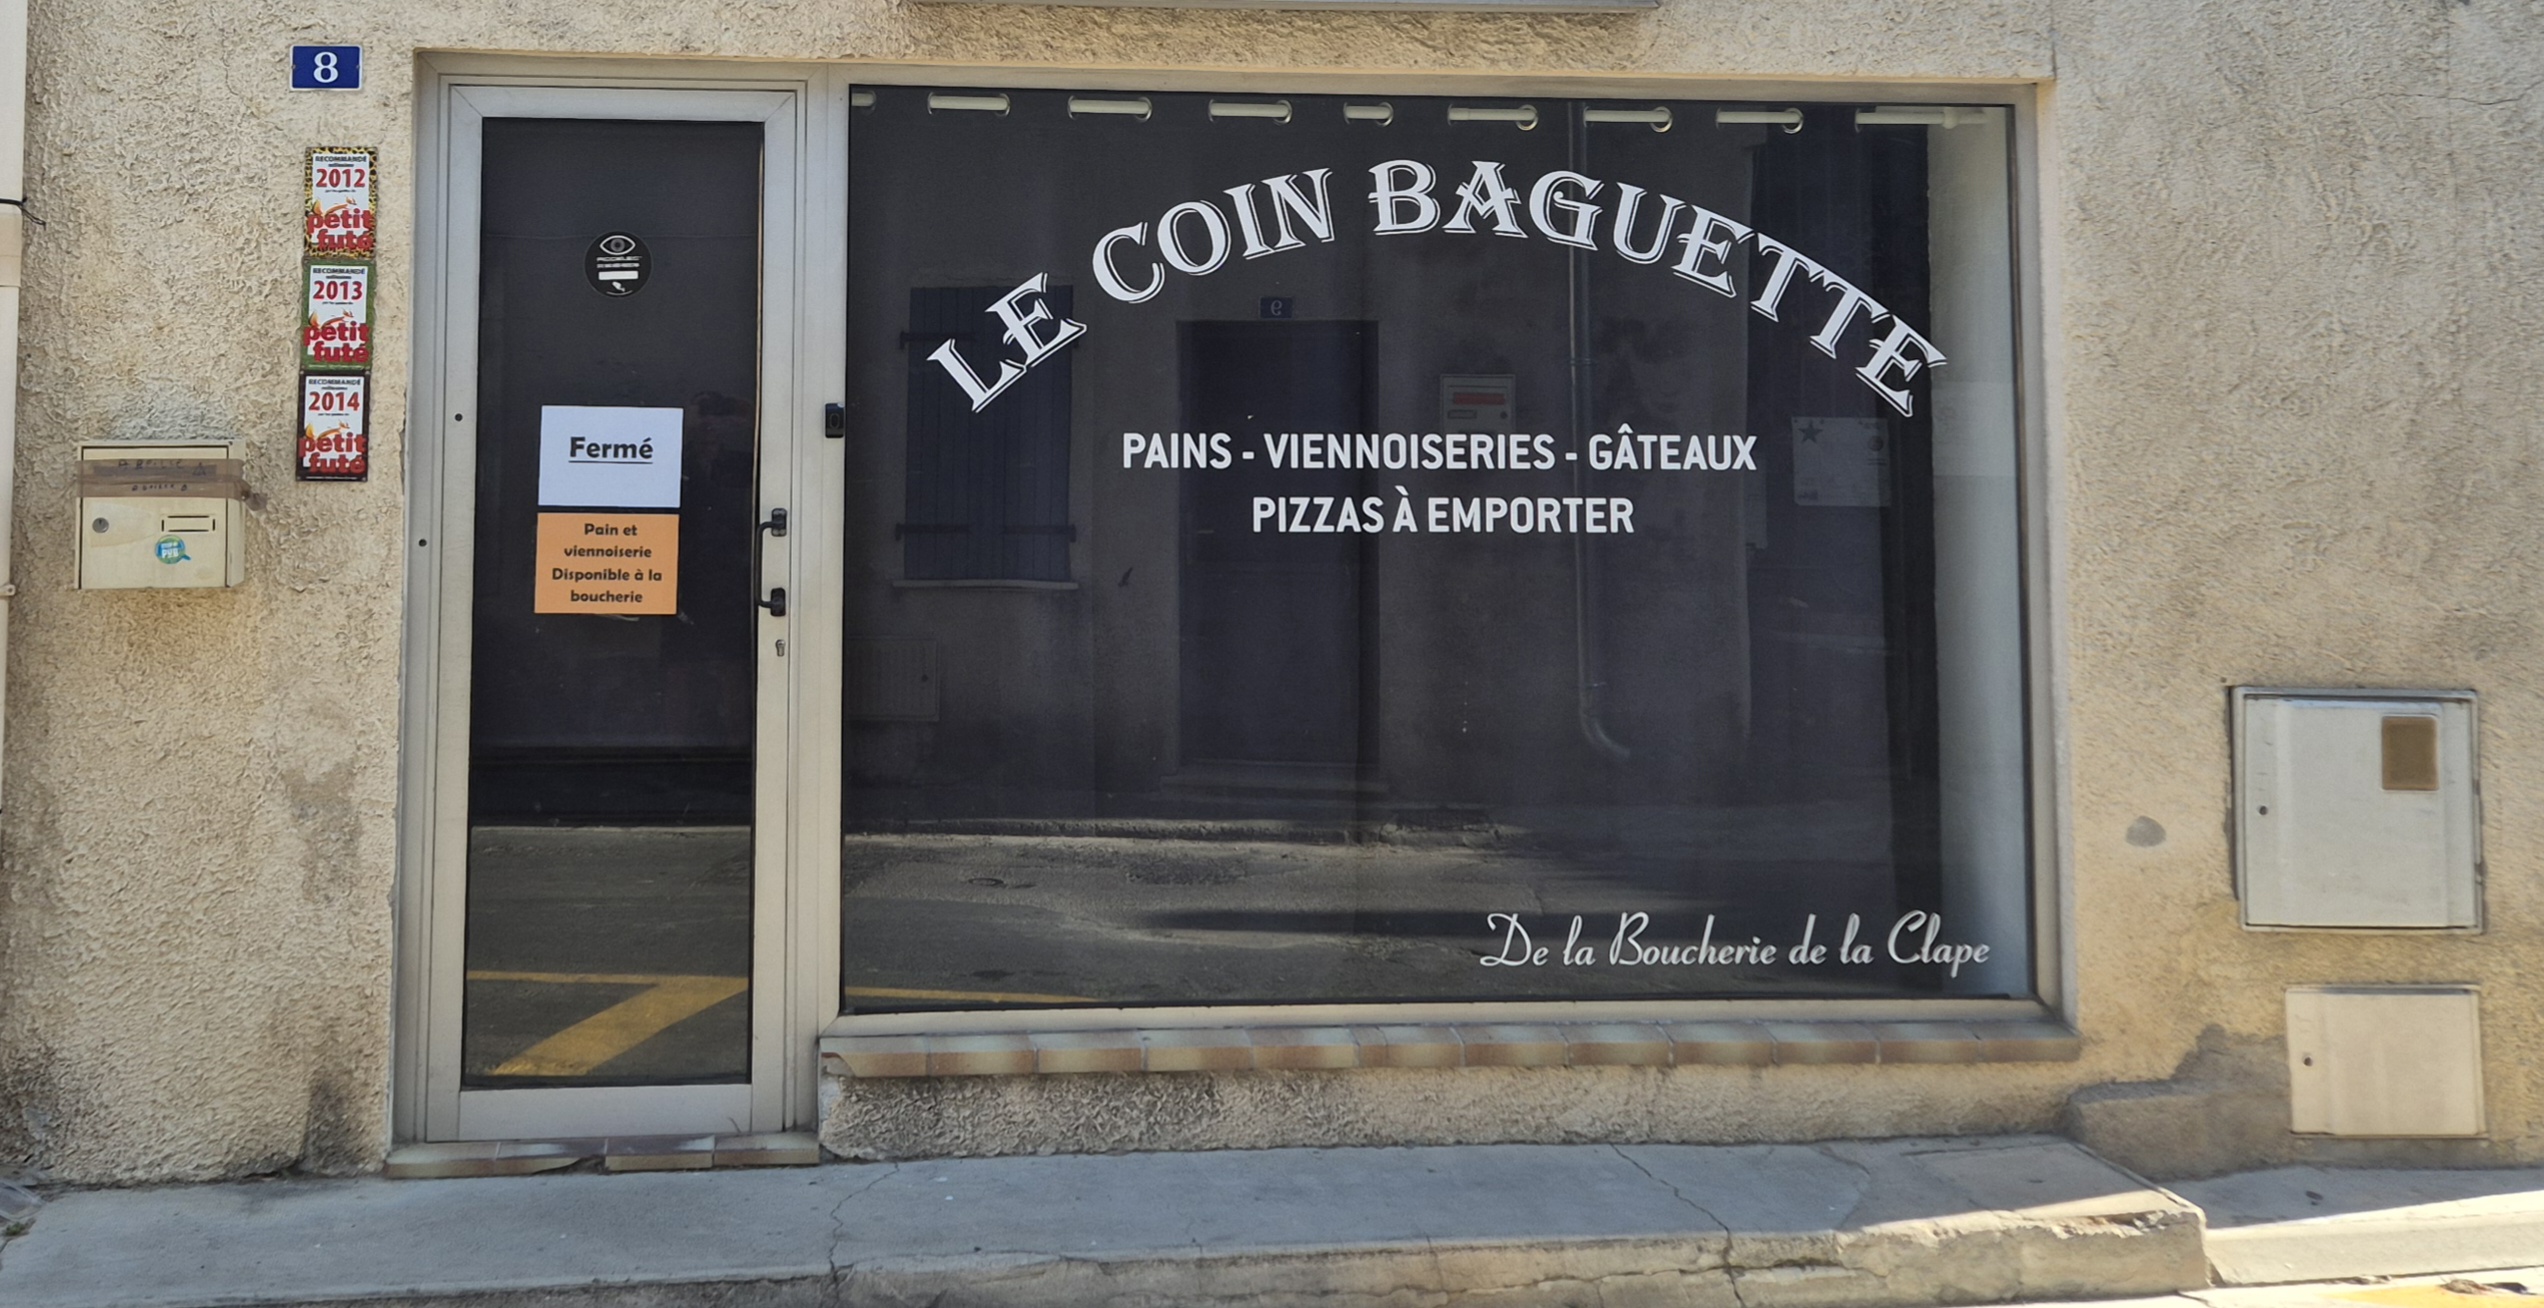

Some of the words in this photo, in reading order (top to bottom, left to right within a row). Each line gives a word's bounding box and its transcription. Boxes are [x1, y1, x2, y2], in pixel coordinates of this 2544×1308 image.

[313, 51, 339, 83] 8
[316, 168, 366, 188] 2012
[307, 208, 374, 234] petit
[317, 228, 374, 251] futé
[313, 280, 363, 300] 2013
[926, 271, 1087, 413] LE
[1092, 168, 1335, 304] COIN
[1367, 158, 1948, 418] BAGUETTE
[303, 320, 370, 346] petit
[313, 340, 370, 362] futé
[308, 391, 360, 412] 2014
[299, 431, 367, 457] petit
[568, 436, 654, 460] Fermé
[1123, 432, 1233, 469] PAINS
[1263, 432, 1556, 470] VIENNOISERIES
[1588, 422, 1758, 470] GÂTEAUX
[309, 452, 367, 474] futé
[1252, 496, 1385, 533] PIZZAS
[1392, 485, 1419, 533] À
[1428, 496, 1635, 533] EMPORTER
[584, 523, 619, 536] Pain
[623, 524, 638, 536] et
[564, 545, 653, 558] viennoiserie
[552, 568, 631, 582] Disponible
[634, 569, 645, 581] à
[648, 569, 663, 582] la
[570, 590, 643, 603] boucherie
[1479, 911, 1549, 967] De
[1562, 914, 1597, 966] la
[1609, 911, 1778, 966] Boucherie
[1788, 913, 1830, 965] de
[1839, 912, 1875, 966] la
[1887, 910, 1990, 979] Clape
